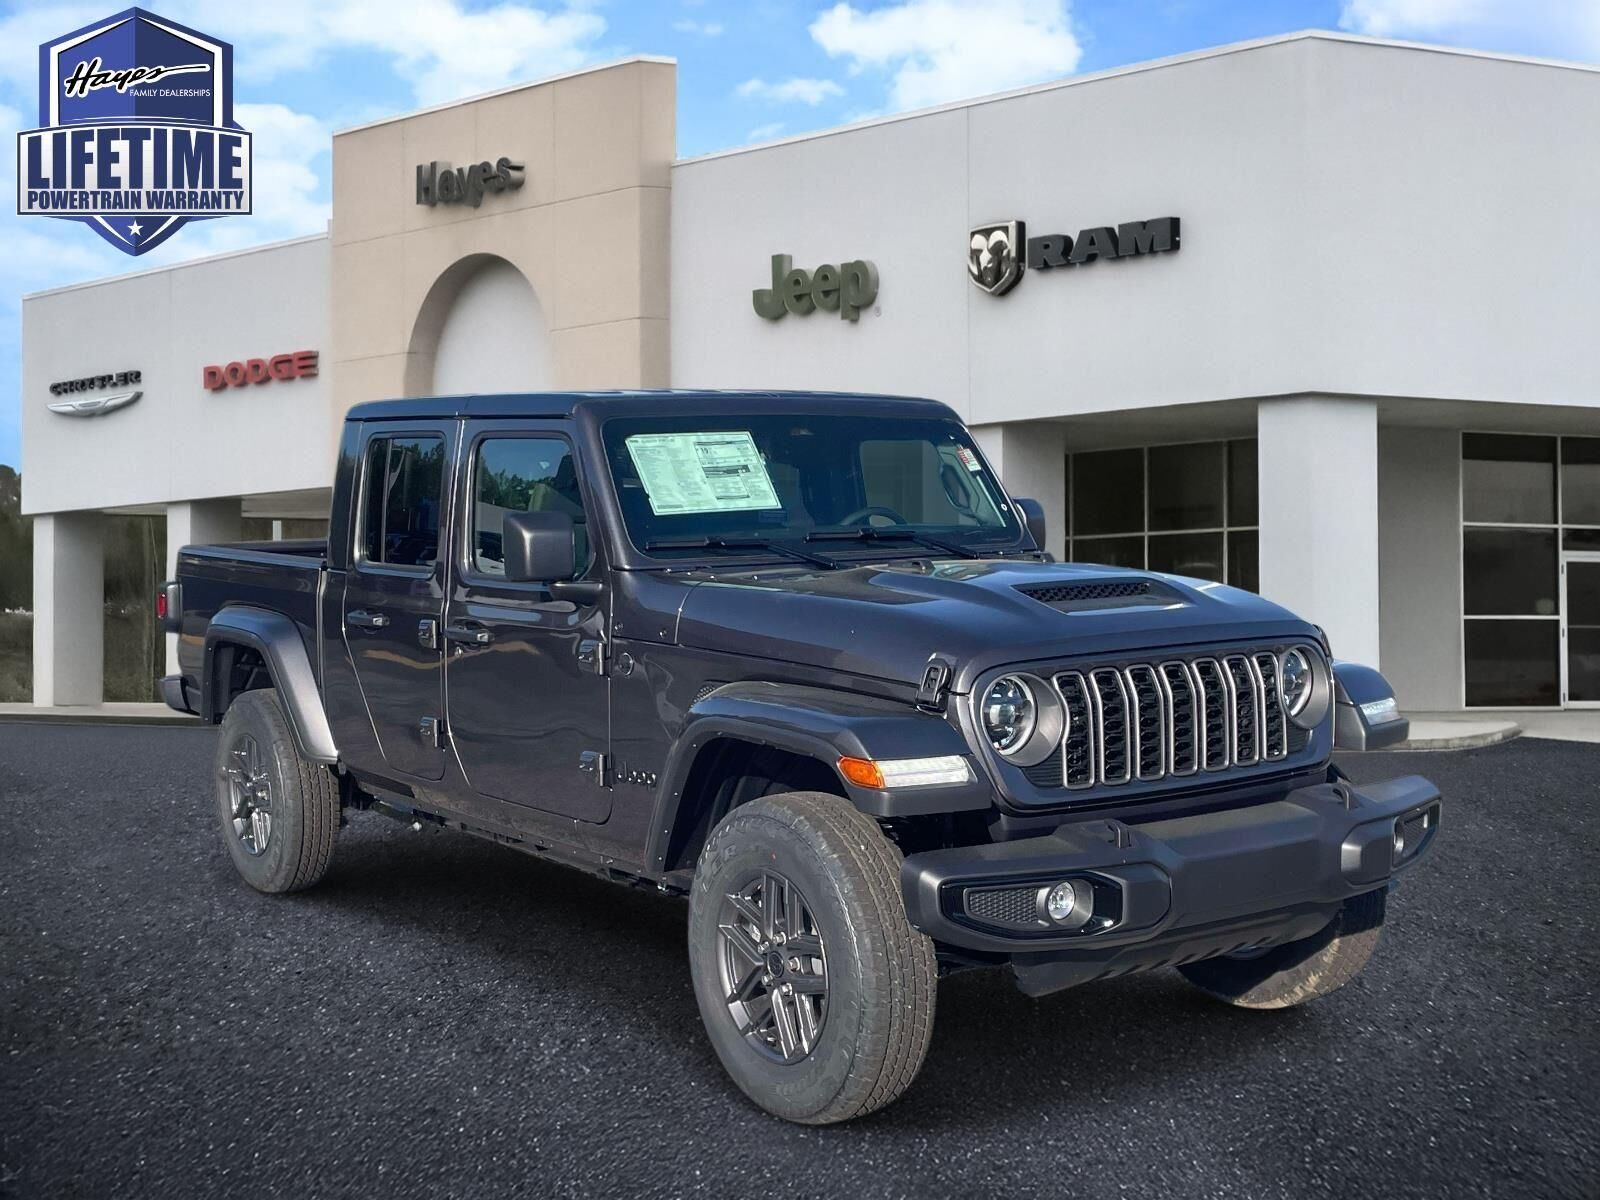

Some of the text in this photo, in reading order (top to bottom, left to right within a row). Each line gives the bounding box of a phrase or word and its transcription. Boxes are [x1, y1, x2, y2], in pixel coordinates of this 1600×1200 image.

[416, 157, 525, 208] Hayes
[1027, 217, 1180, 272] RAM
[753, 254, 879, 321] Jeep
[49, 370, 142, 395] CHRYSLER
[203, 350, 319, 391] DODGE
